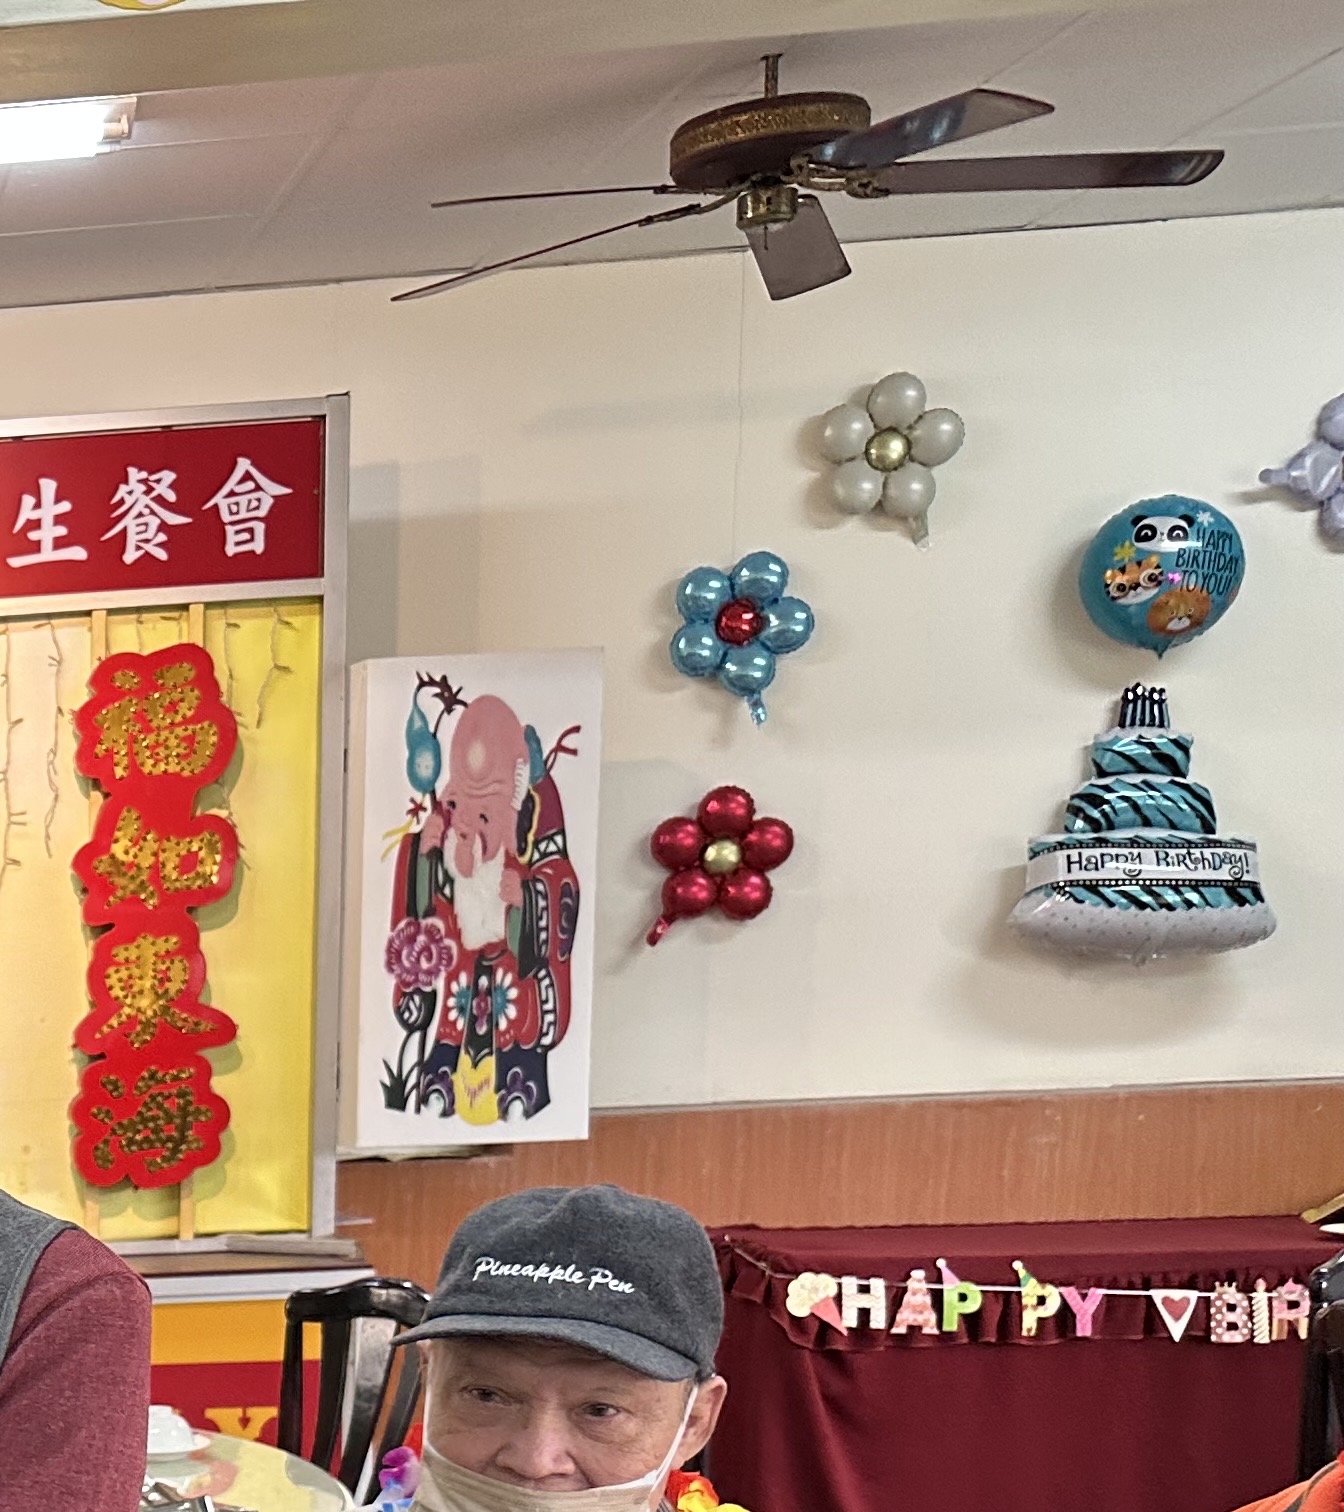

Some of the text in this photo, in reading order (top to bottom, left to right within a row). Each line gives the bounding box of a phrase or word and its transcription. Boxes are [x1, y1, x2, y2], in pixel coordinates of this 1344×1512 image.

[1196, 526, 1233, 553] HAPPY
[1175, 547, 1240, 576] BIRTHDAY
[1179, 569, 1199, 593] TO
[472, 1256, 635, 1294] Pineapple Pen
